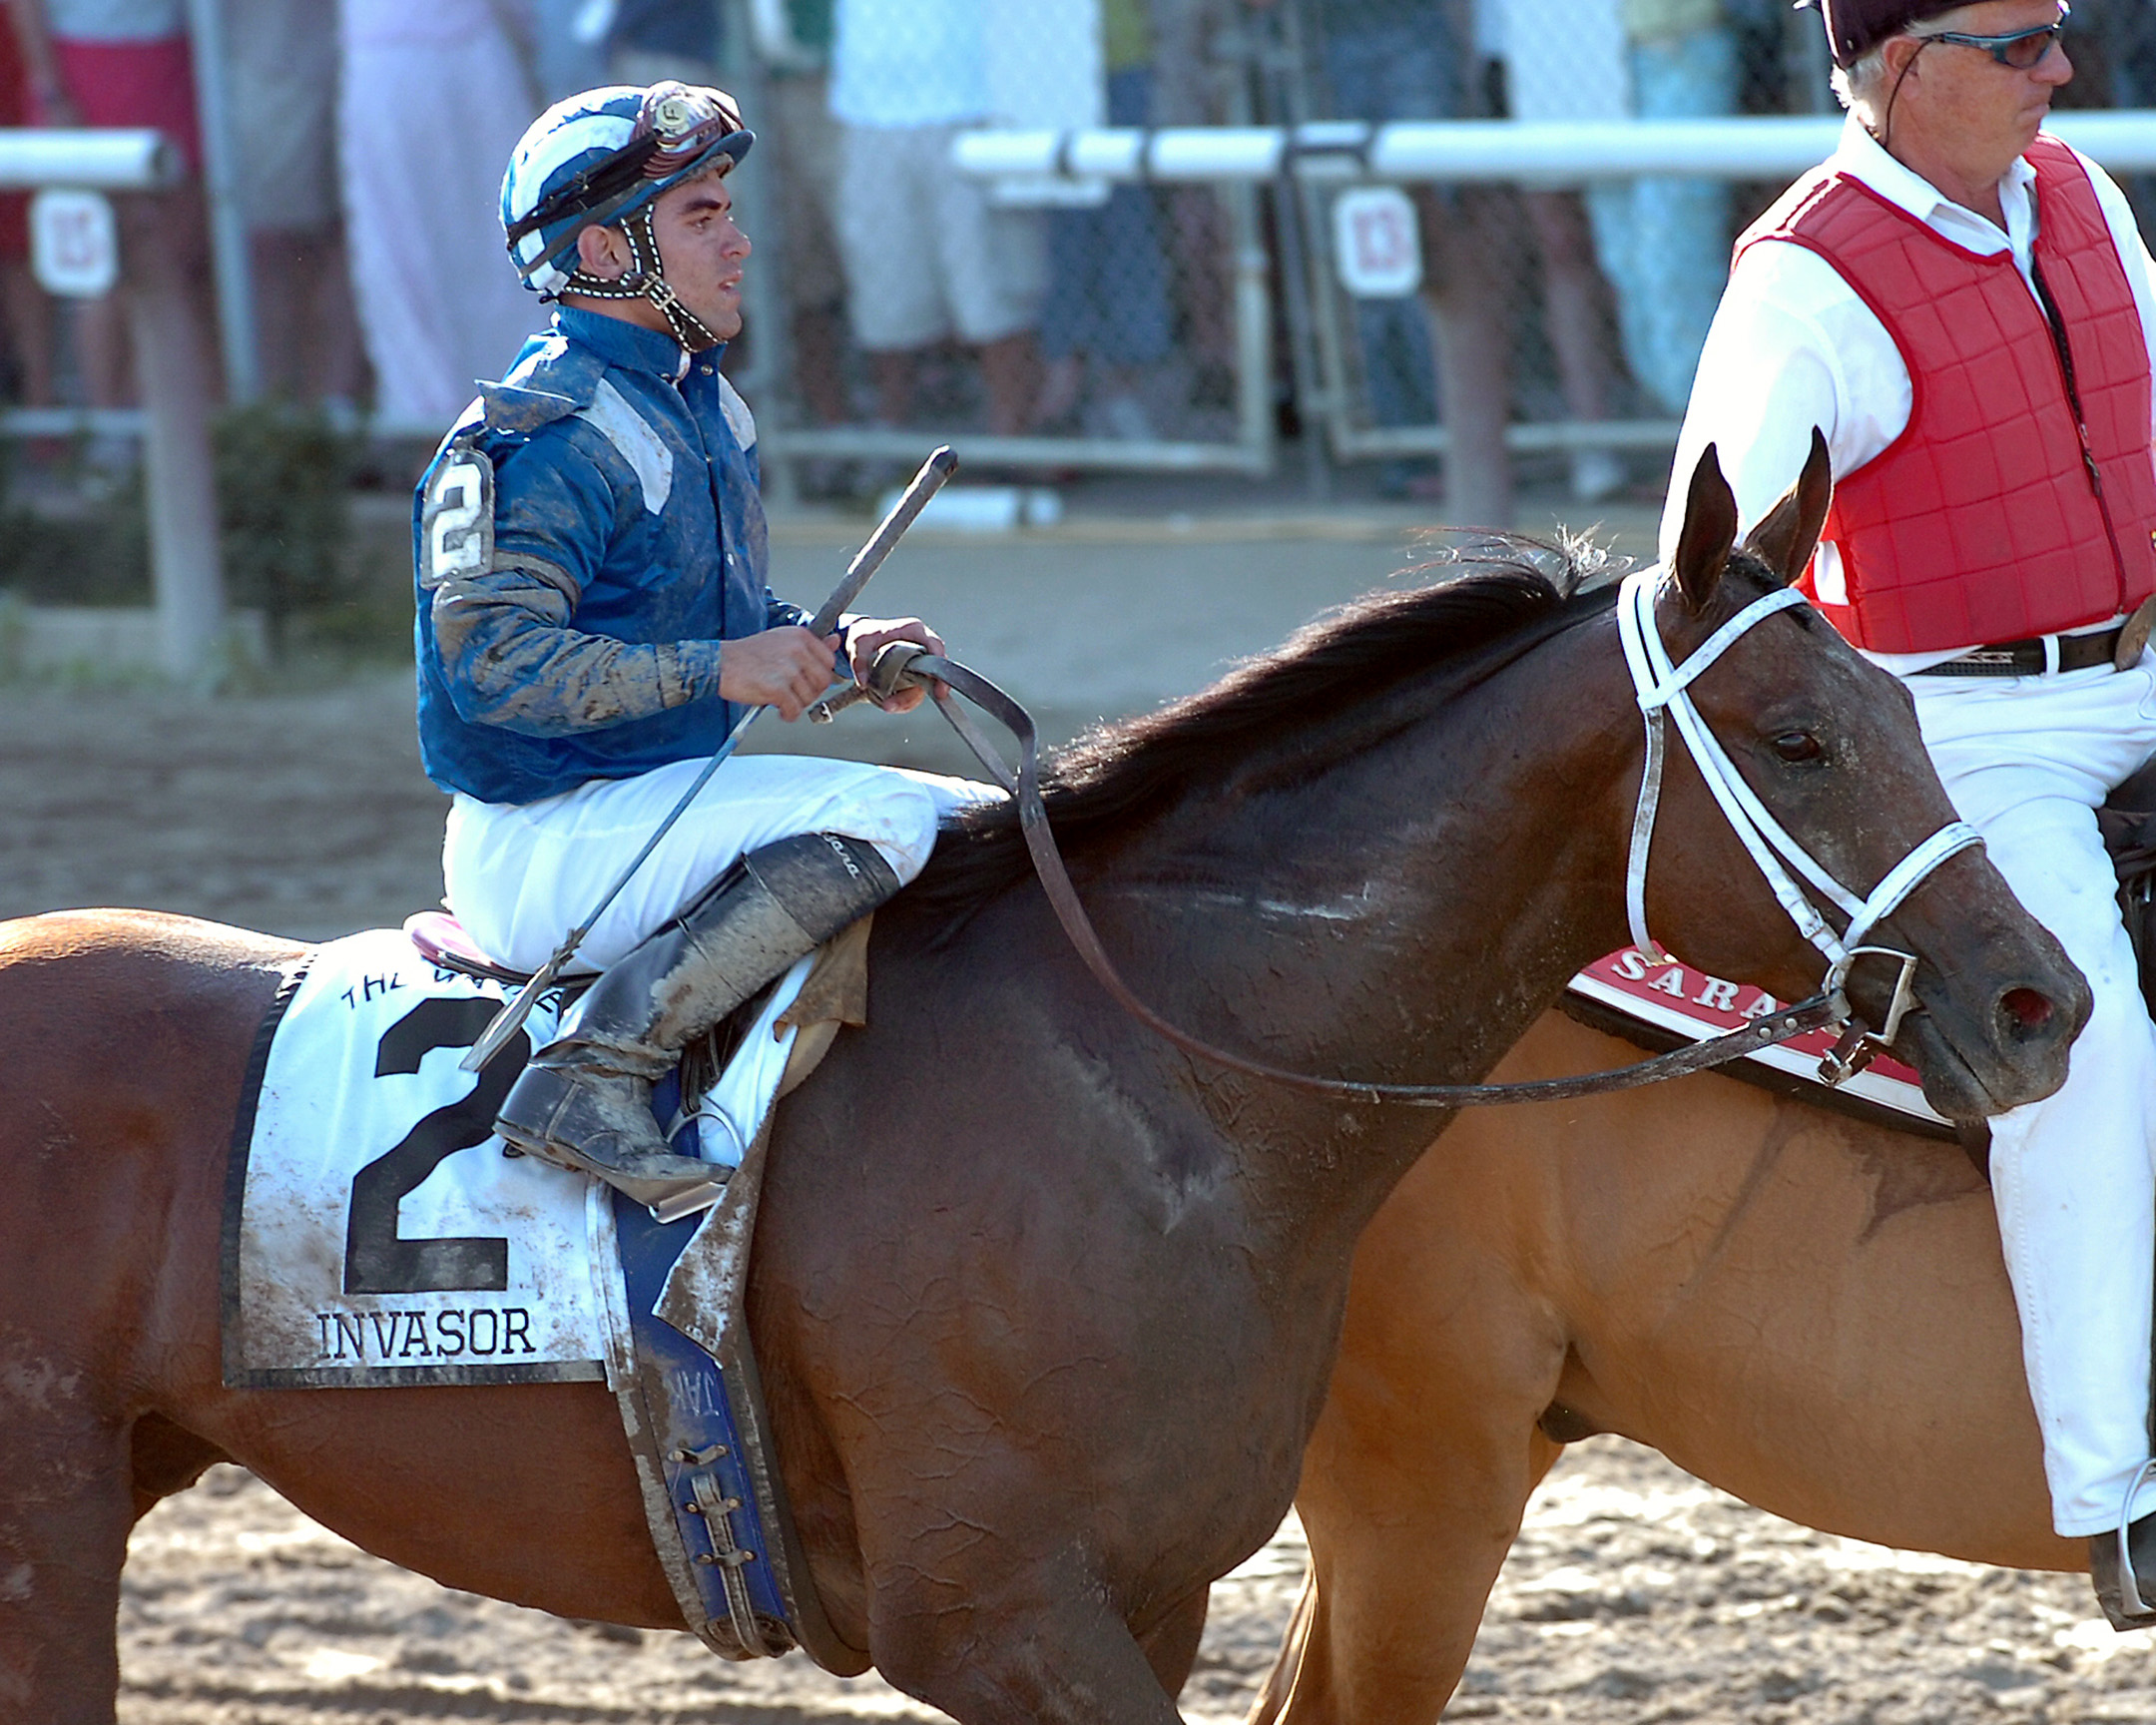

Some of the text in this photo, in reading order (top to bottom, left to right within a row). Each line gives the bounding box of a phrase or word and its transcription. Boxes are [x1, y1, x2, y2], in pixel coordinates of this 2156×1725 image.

[431, 462, 482, 579] 2
[344, 996, 532, 1295] 2
[315, 1307, 537, 1360] INVASOR
